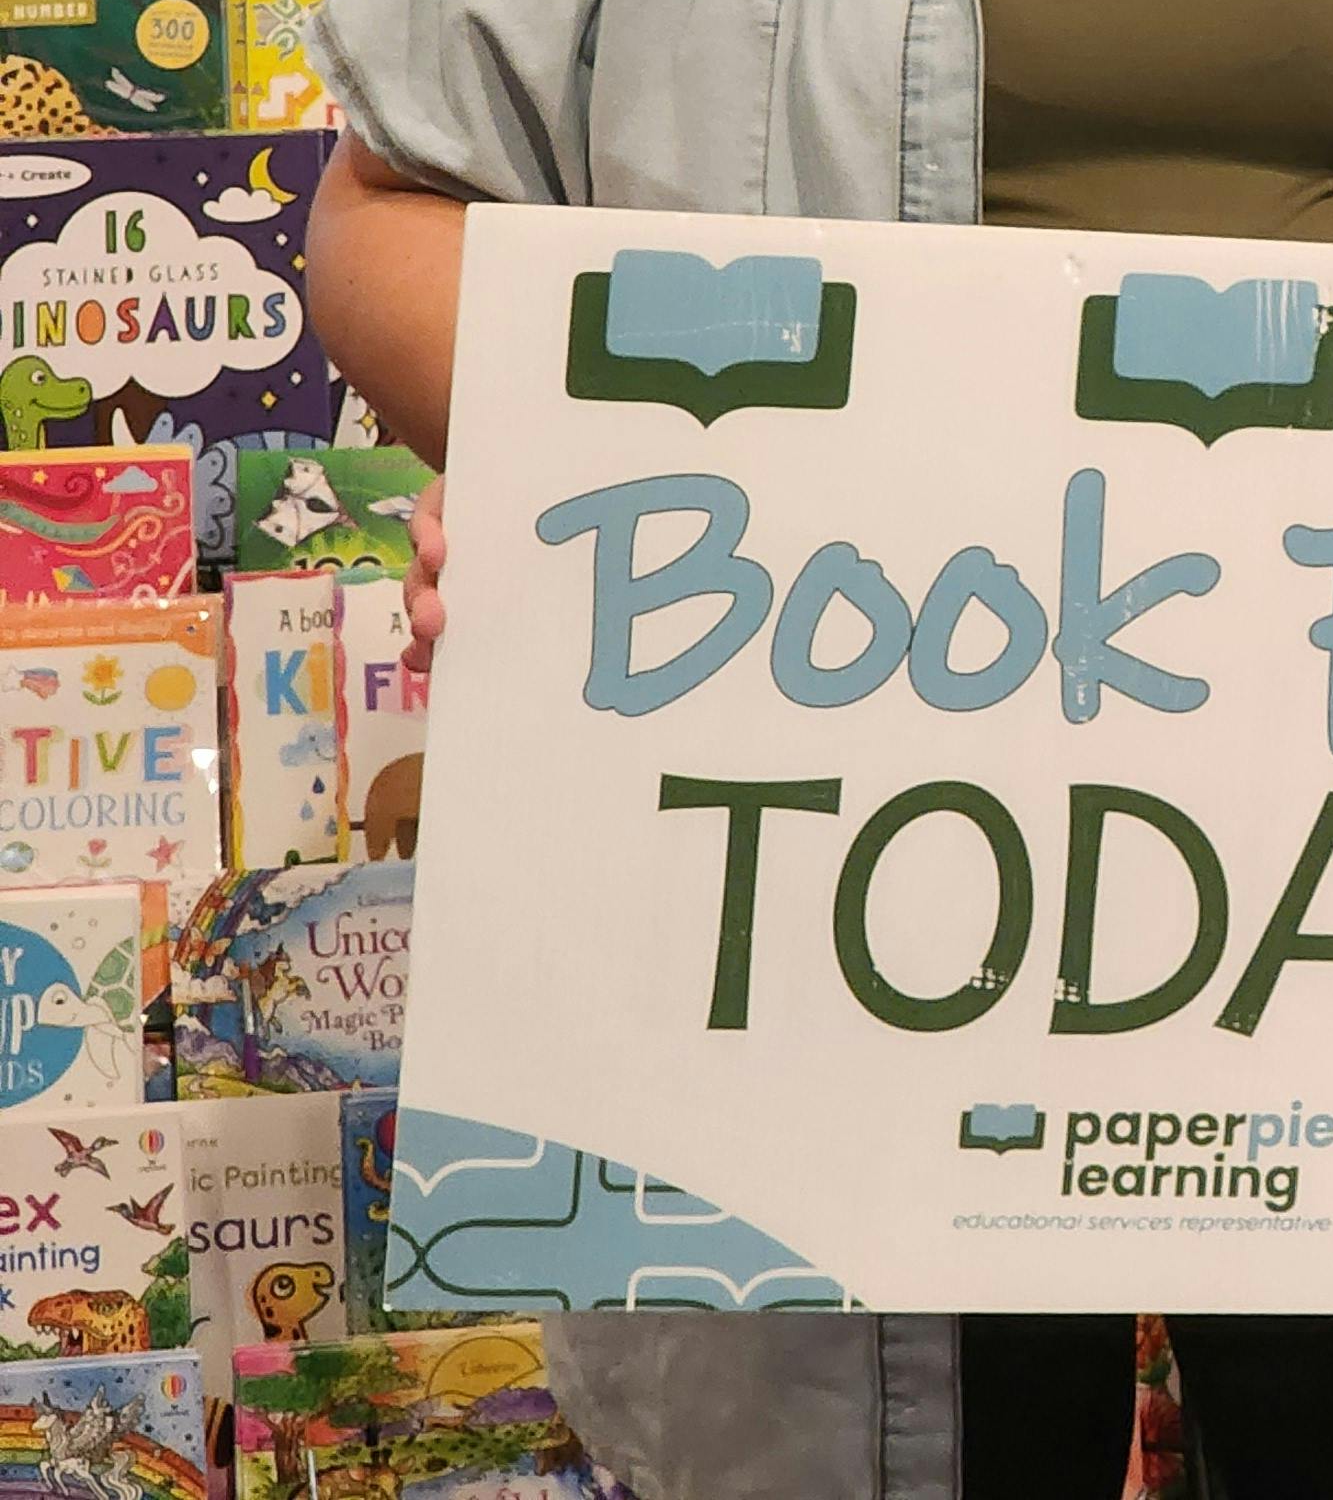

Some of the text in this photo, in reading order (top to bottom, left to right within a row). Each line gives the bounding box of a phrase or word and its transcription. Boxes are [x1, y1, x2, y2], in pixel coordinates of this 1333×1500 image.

[151, 18, 195, 40] 300
[105, 209, 147, 254] 16
[43, 263, 219, 286] STAINED GLASS
[0, 293, 286, 348] INOSAURS
[535, 469, 1221, 724] Book
[280, 610, 292, 631] A
[391, 612, 403, 632] A
[317, 959, 406, 1001] Wo
[301, 1008, 376, 1036] Magic
[225, 1161, 341, 1190] Painting
[1062, 1152, 1300, 1212] learning
[188, 1210, 334, 1253] saurs
[953, 1212, 1332, 1233] educational services representative
